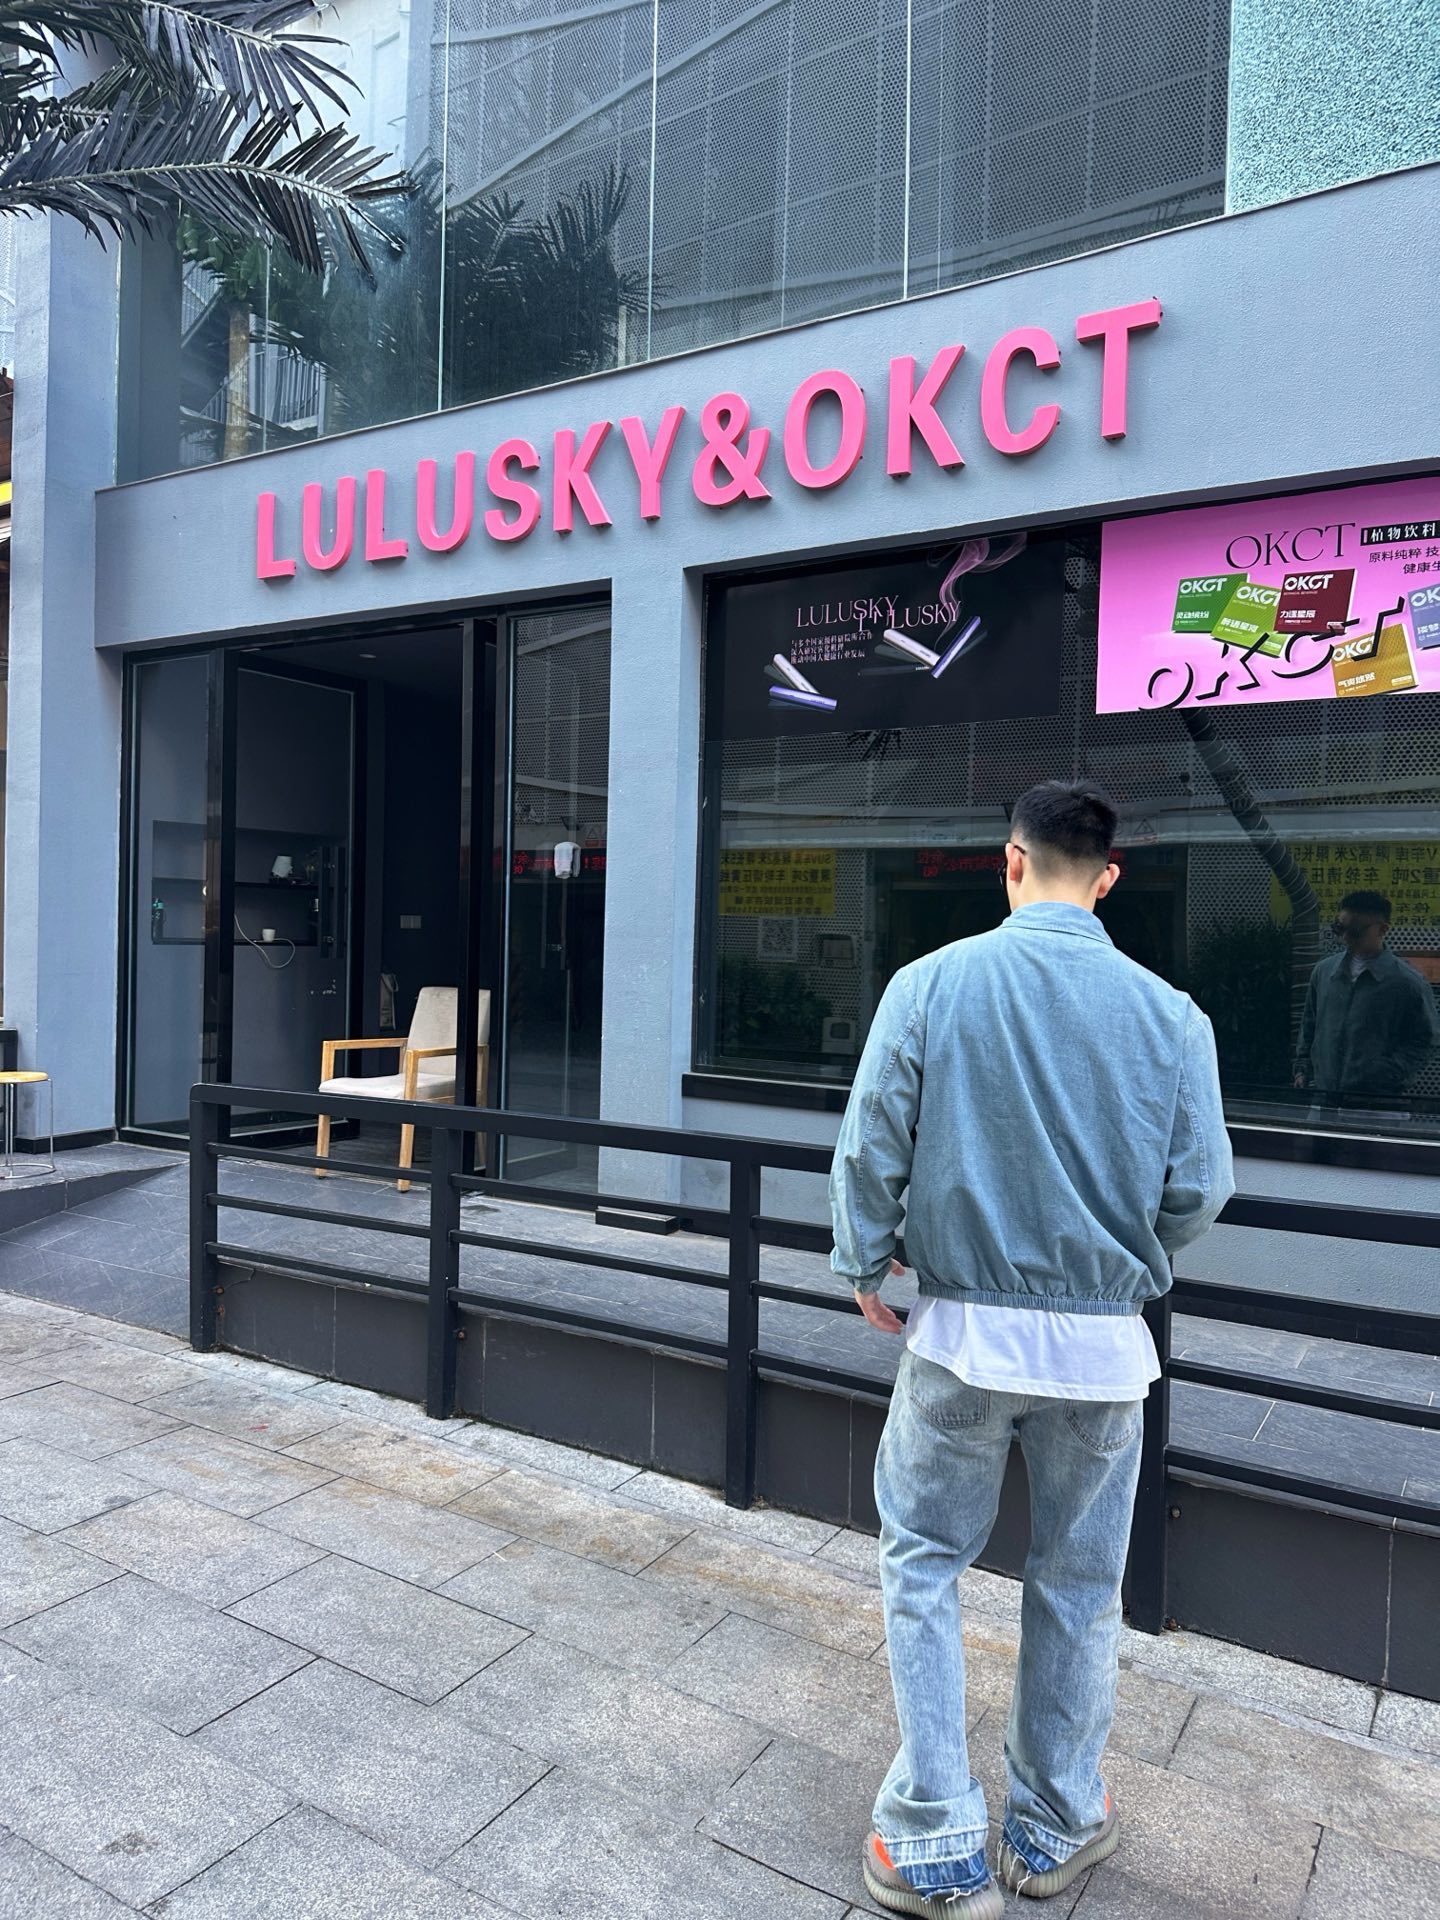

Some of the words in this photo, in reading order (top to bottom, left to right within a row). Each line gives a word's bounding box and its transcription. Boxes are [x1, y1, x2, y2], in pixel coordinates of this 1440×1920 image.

[256, 296, 1162, 581] LULUSKY&OKCT
[1225, 522, 1356, 570] OKCT
[1370, 523, 1437, 543] 植物饮料
[1368, 547, 1422, 563] 原料纯粹
[1425, 546, 1440, 558] 技
[796, 595, 899, 628] LULUSKY
[1332, 635, 1375, 662] OKC
